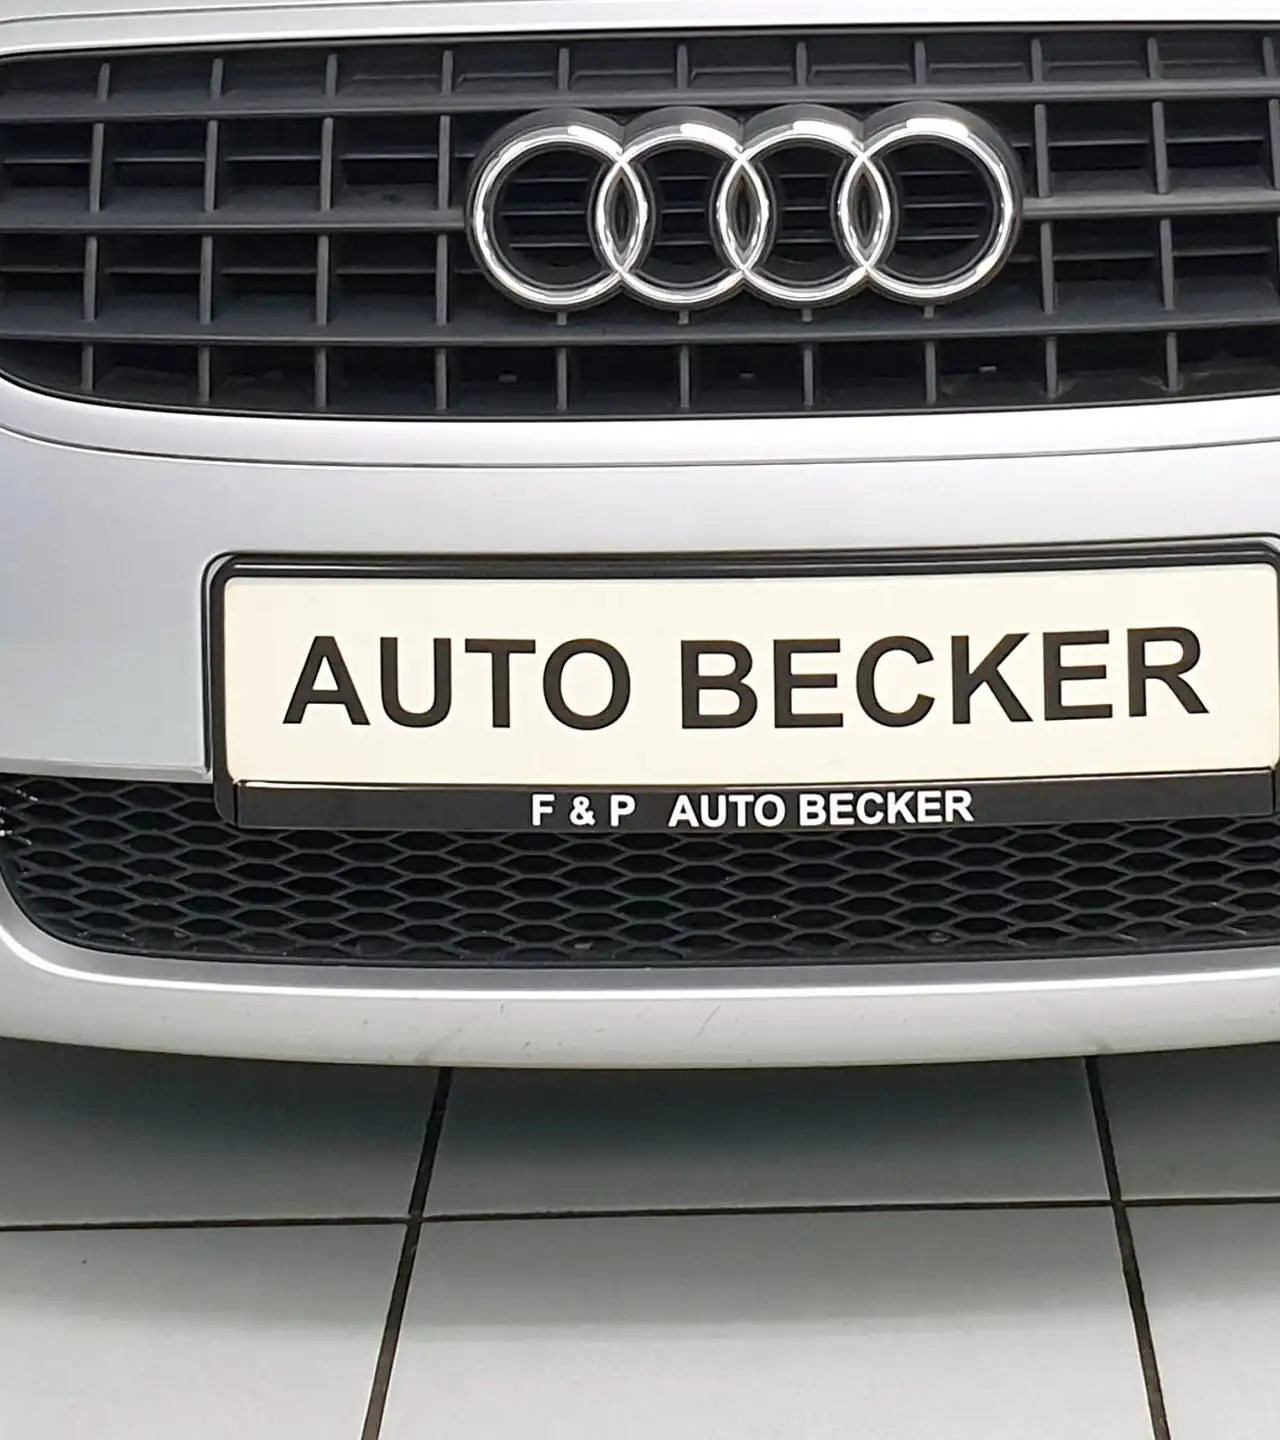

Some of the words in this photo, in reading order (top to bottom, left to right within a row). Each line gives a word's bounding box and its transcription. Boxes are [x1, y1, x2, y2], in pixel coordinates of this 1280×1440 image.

[282, 635, 632, 731] AUTO
[680, 626, 1210, 730] BECKER
[531, 793, 556, 826] F
[569, 795, 596, 827] &
[610, 793, 637, 827] P
[667, 793, 787, 828] AUTO
[798, 789, 975, 828] BECKER
